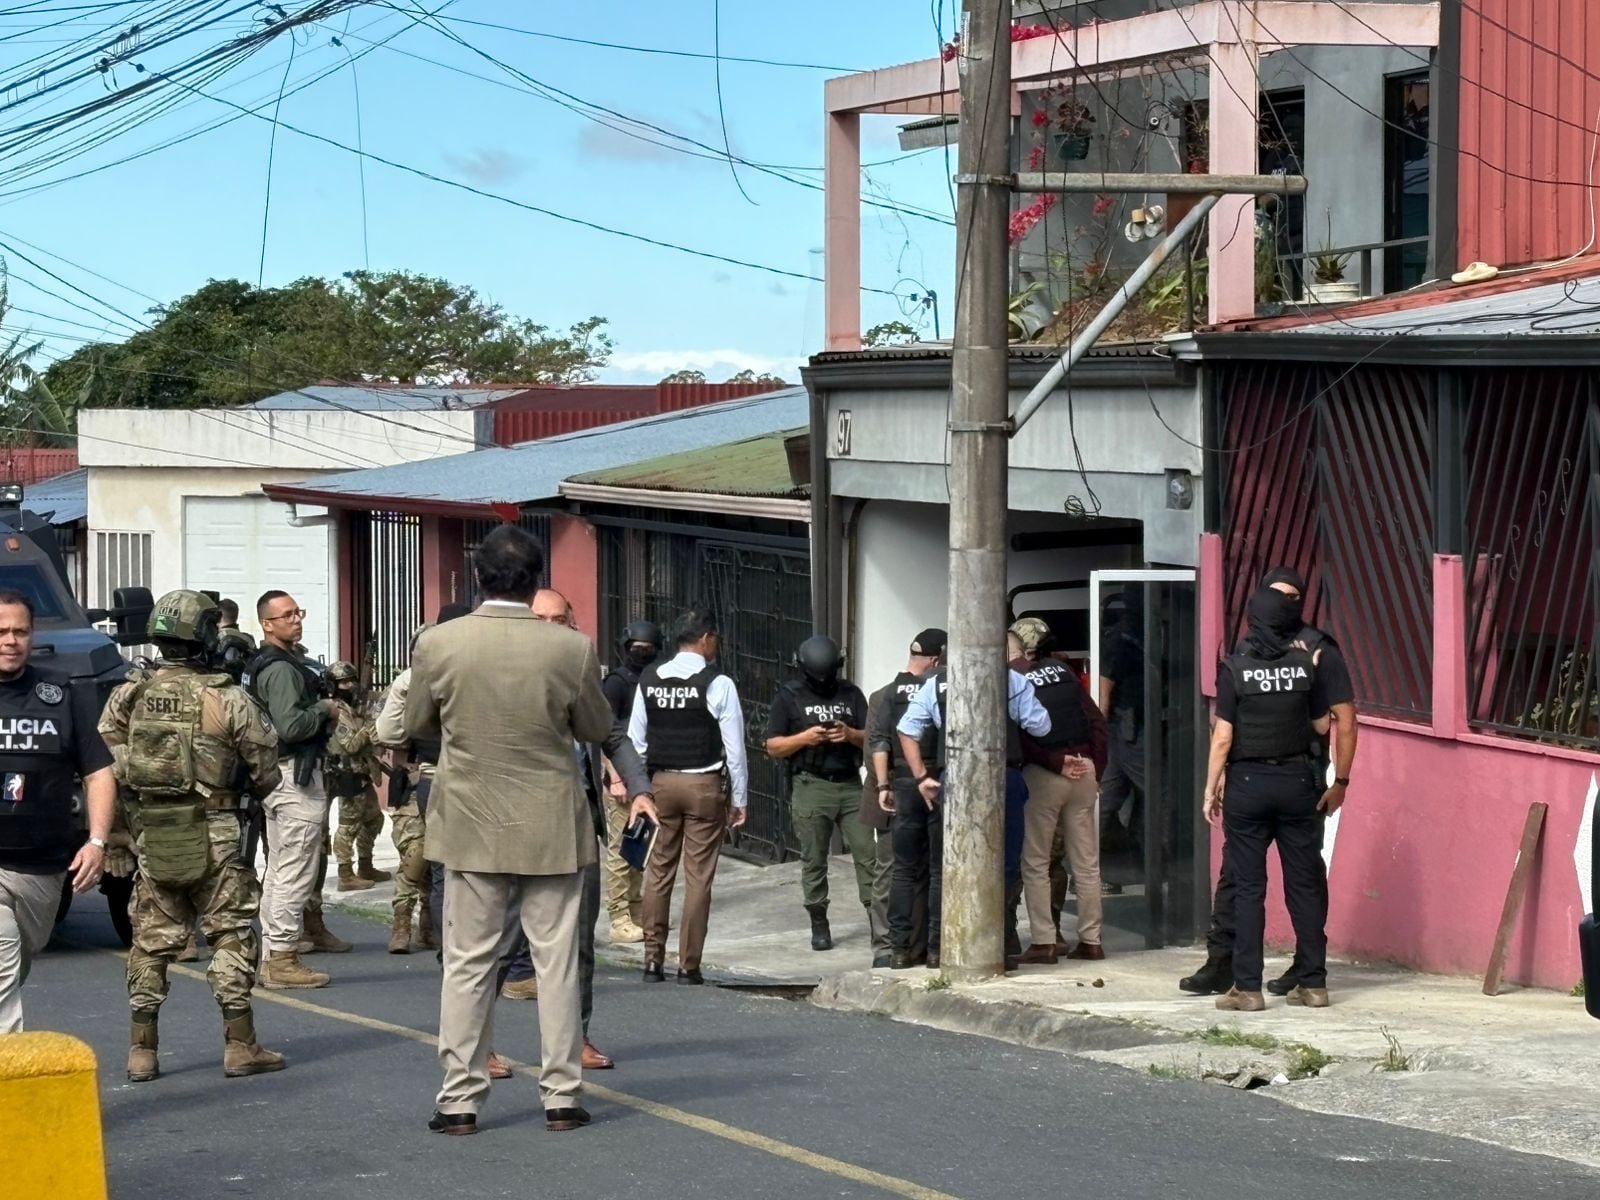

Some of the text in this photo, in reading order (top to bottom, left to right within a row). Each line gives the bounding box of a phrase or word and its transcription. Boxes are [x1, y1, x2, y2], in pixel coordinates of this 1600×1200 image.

[838, 412, 851, 454] 97
[1025, 665, 1067, 680] OLICIA
[1243, 666, 1308, 682] POLICIA
[646, 686, 699, 699] POLICIA
[1260, 679, 1293, 692] OIJ
[146, 697, 180, 714] SERT
